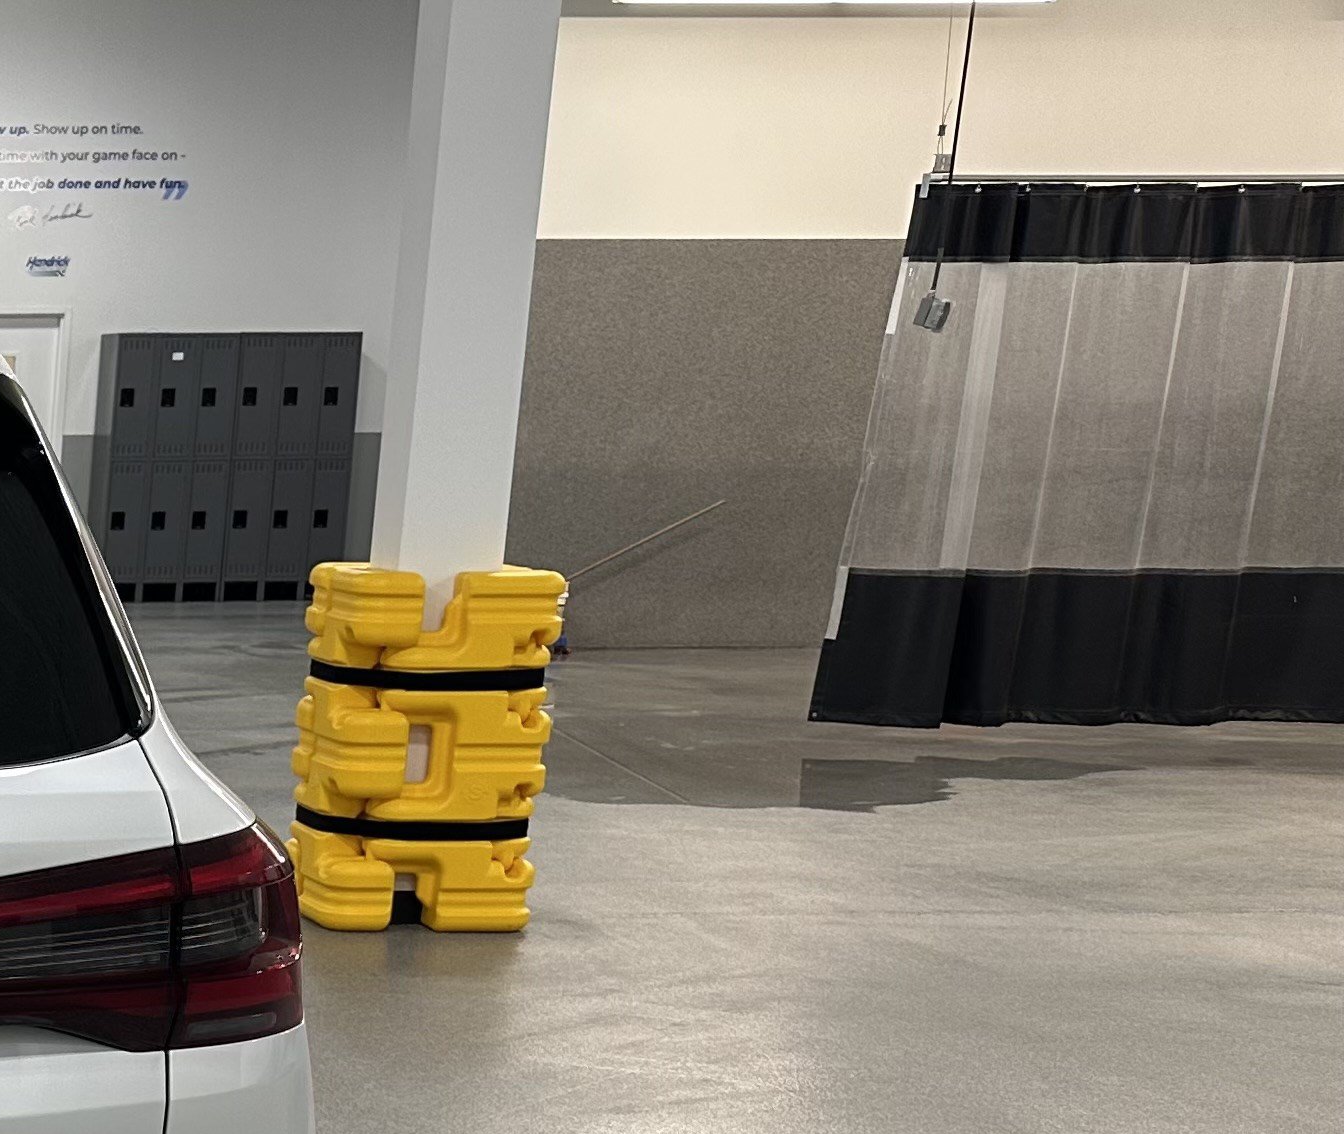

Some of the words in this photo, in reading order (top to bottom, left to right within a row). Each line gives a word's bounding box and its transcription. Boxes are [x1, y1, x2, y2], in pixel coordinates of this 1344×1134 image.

[9, 126, 30, 136] up.
[34, 124, 69, 135] Show
[72, 125, 89, 136] up
[91, 125, 108, 135] on
[111, 123, 144, 135] time.
[30, 150, 58, 162] with
[60, 151, 90, 163] your
[92, 151, 129, 163] game
[132, 149, 158, 161] face
[161, 151, 178, 161] on
[8, 179, 30, 190] the
[31, 178, 55, 193] job
[58, 178, 91, 189] done
[94, 178, 121, 189] and
[124, 178, 157, 189] have
